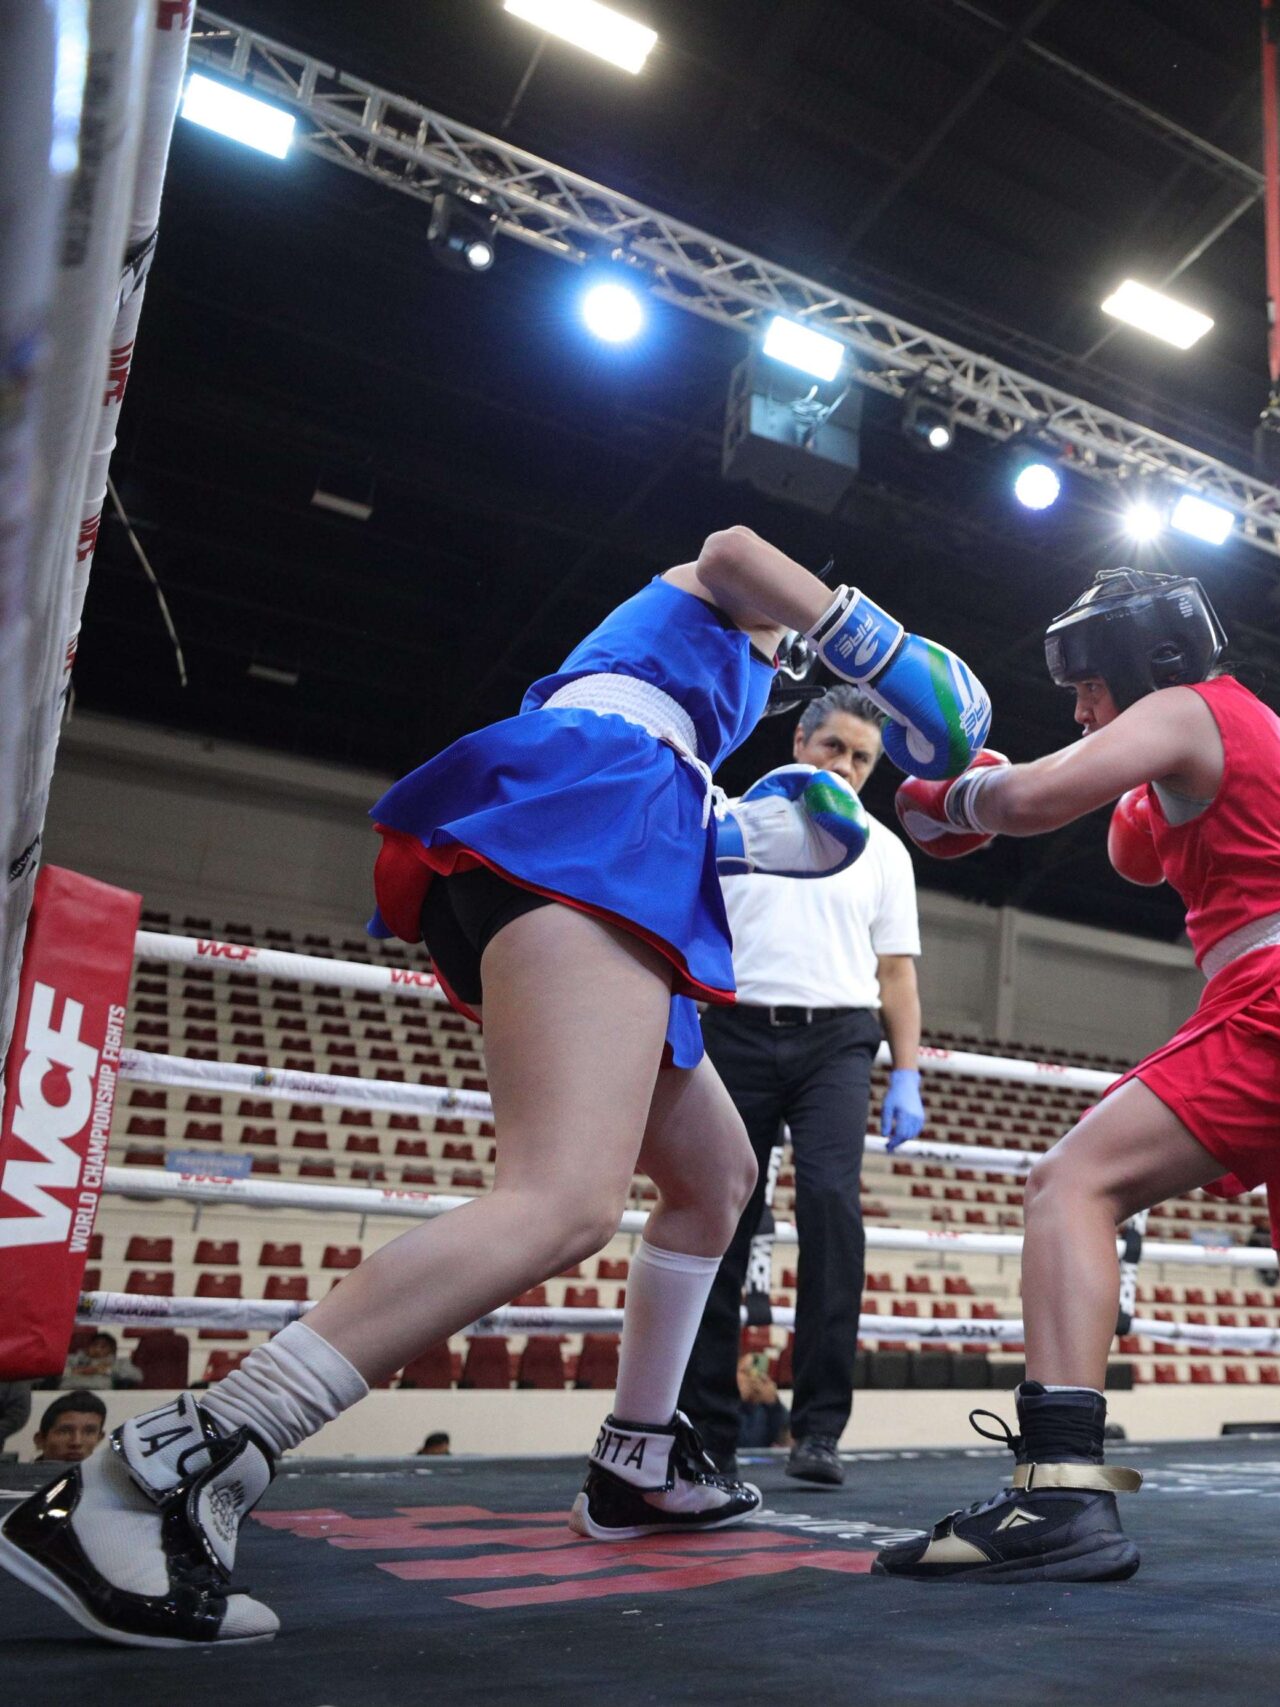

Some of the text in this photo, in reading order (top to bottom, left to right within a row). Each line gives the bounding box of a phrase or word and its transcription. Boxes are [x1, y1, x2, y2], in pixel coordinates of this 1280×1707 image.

[838, 613, 873, 659] FIRE
[0, 980, 99, 1248] WCF
[68, 1003, 127, 1254] WORLD CHAMPIONSHIP FIGHTS
